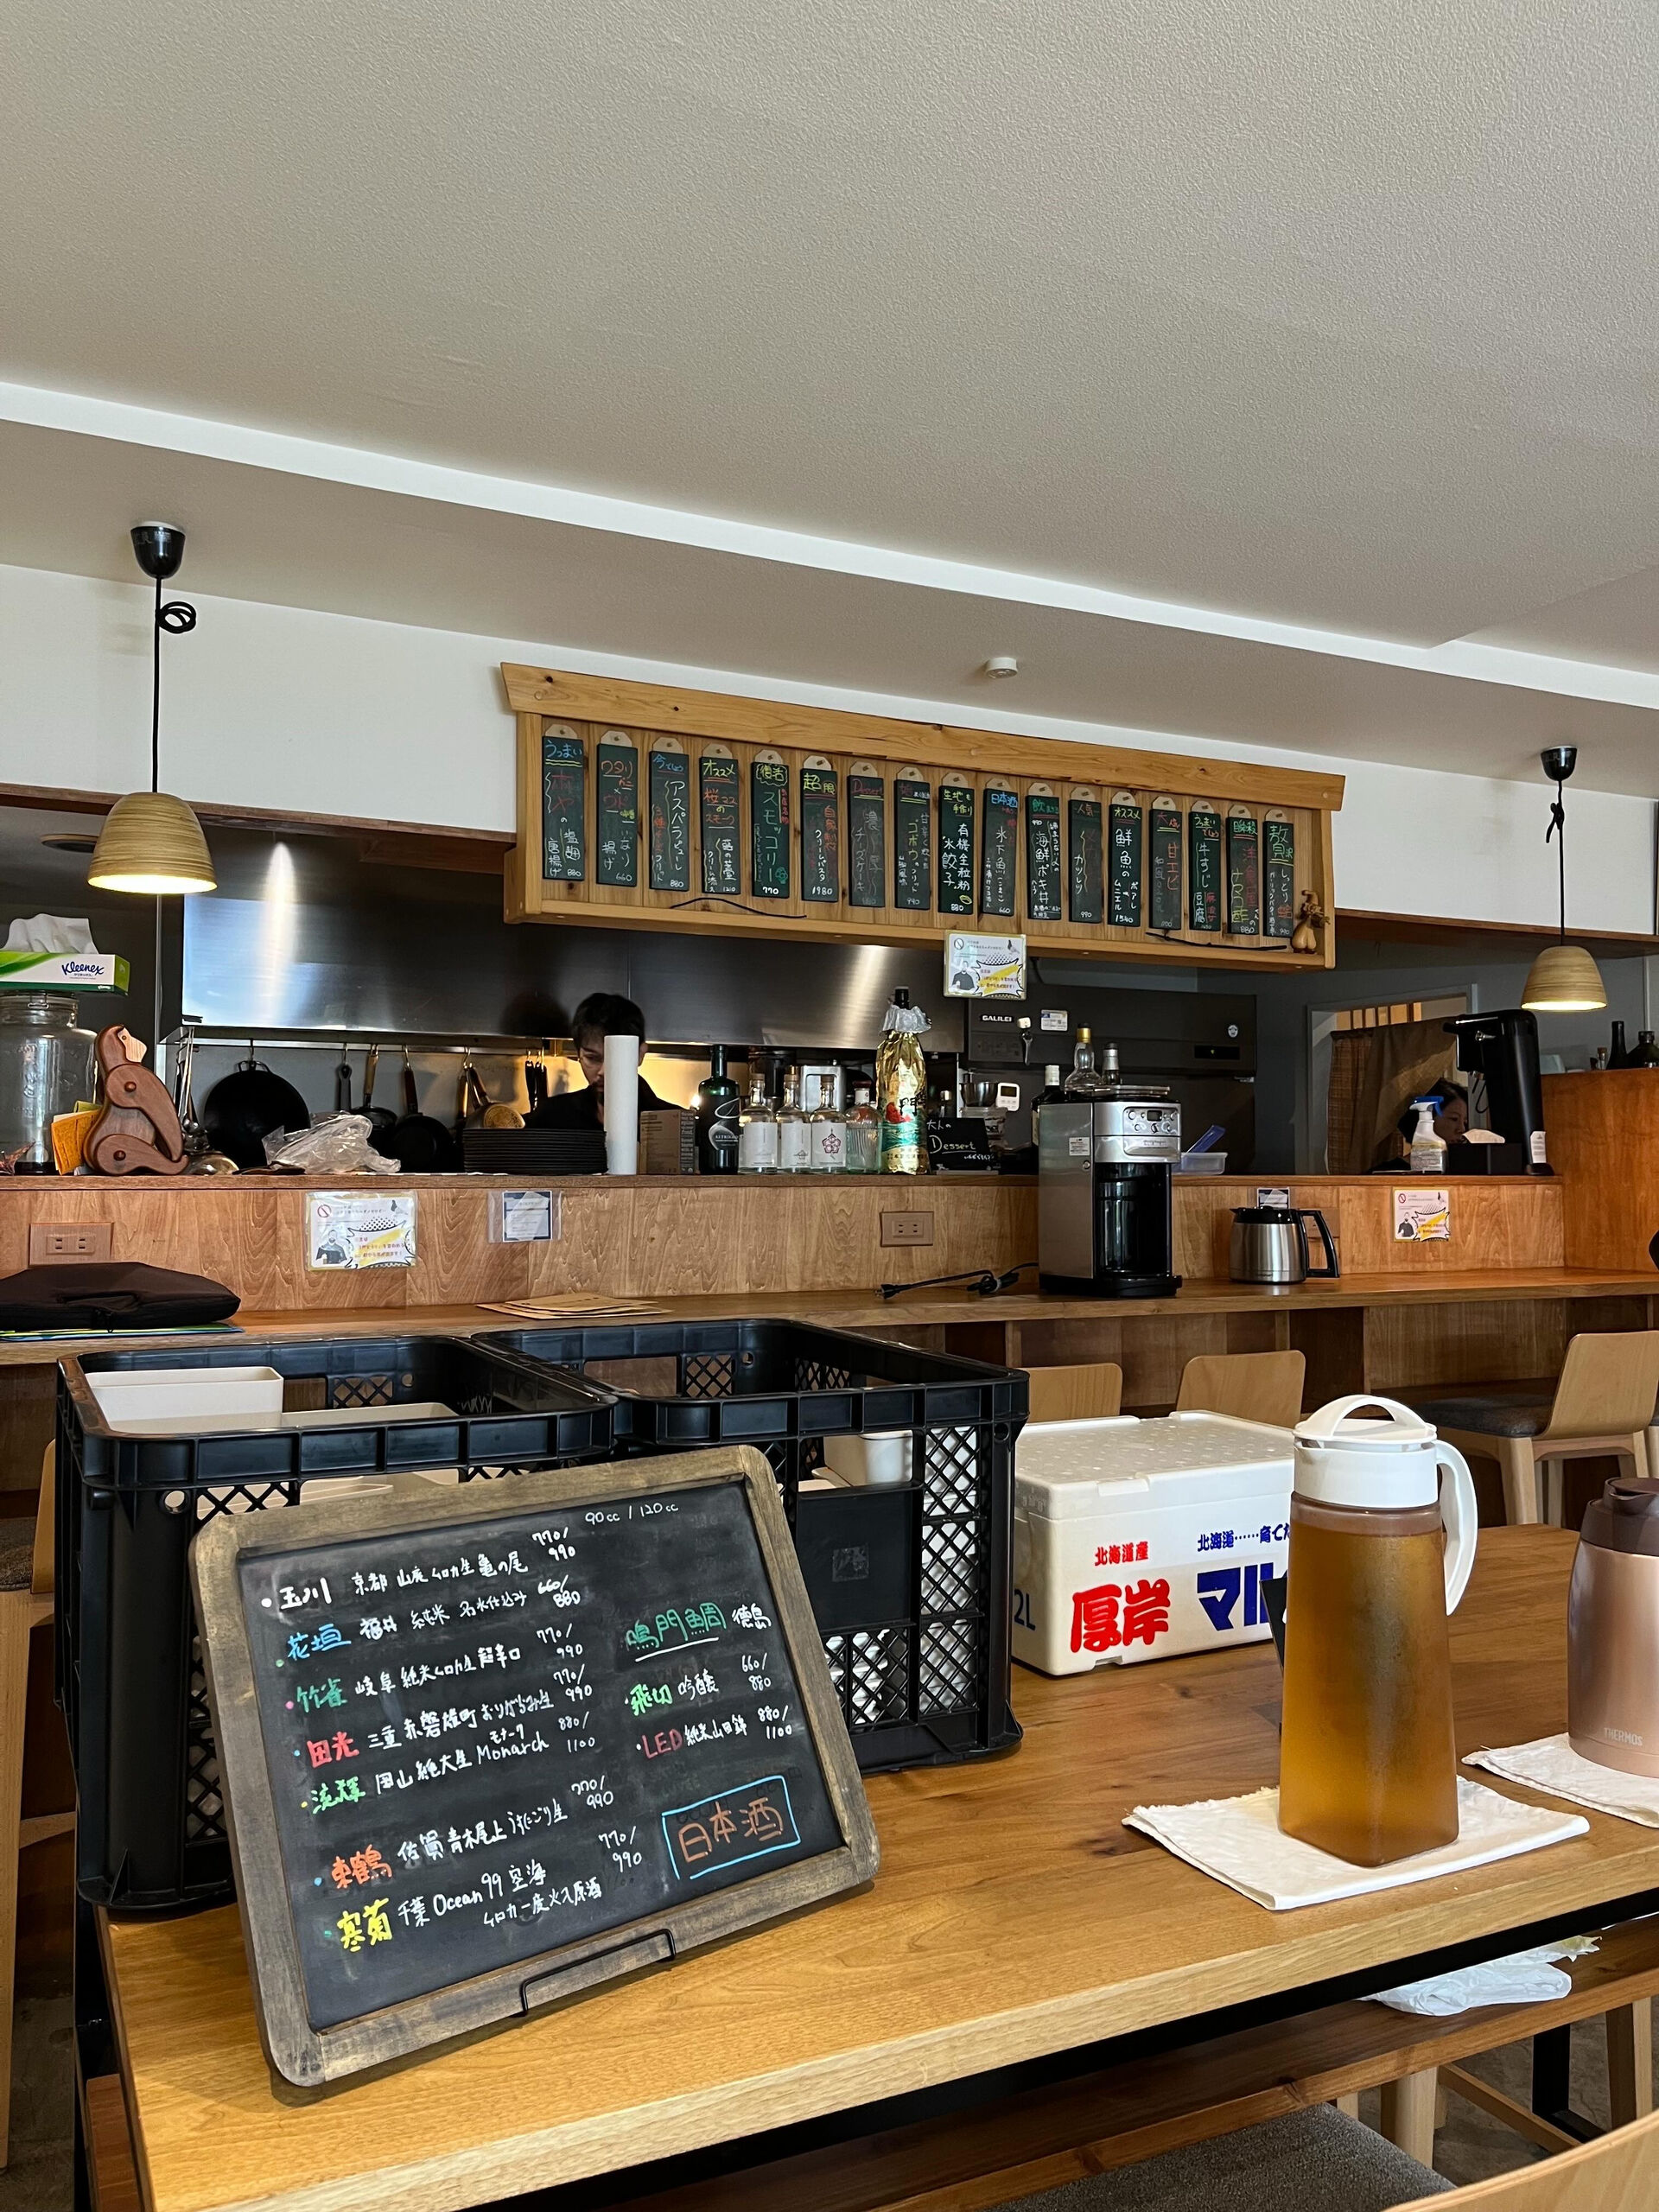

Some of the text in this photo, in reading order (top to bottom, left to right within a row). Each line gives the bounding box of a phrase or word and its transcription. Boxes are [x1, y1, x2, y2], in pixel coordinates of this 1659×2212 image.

[703, 759, 735, 776] オススメ
[1114, 807, 1141, 820] オススメ
[942, 837, 957, 887] 水餃子
[956, 823, 971, 891] 有機全粒粉
[1198, 842, 1211, 888] 牛すじ
[615, 873, 632, 881] 660
[1074, 854, 1084, 894] カツレツ
[762, 887, 779, 895] 770
[811, 887, 833, 895] 1980
[1115, 915, 1134, 924] 1540
[61, 961, 105, 976] Kleenex
[929, 1135, 976, 1154] Dessert
[585, 1510, 620, 1526] 90cc
[639, 1502, 679, 1517] 120cc
[549, 1544, 576, 1560] 990
[1094, 1541, 1149, 1567] 北海道産
[279, 1578, 332, 1610] 玉川
[352, 1573, 388, 1596] 京都
[553, 1591, 581, 1608] 880
[1197, 1562, 1288, 1631] マル
[1070, 1579, 1171, 1653] 厚岸
[287, 1624, 352, 1661] 花垣
[359, 1615, 397, 1640] 福井
[410, 1604, 450, 1630] 純米
[556, 1644, 583, 1659] 990
[354, 1672, 397, 1697] 岐阜
[565, 1684, 593, 1703] 990
[748, 1675, 772, 1691] 880
[630, 1683, 673, 1716] 飛切
[367, 1725, 402, 1750] 三重
[766, 1725, 792, 1739] 1100
[1604, 1727, 1643, 1746] THERMOS
[567, 1737, 595, 1753] 1100
[641, 1728, 683, 1759] LED
[376, 1770, 414, 1795] 岡山
[476, 1731, 550, 1765] Monarch
[587, 1791, 614, 1810] 990
[677, 1796, 785, 1863] 日本酒
[613, 1851, 643, 1873] 990
[397, 1895, 430, 1928] 千葉
[433, 1890, 483, 1916] Ocean
[481, 1872, 503, 1899] 99
